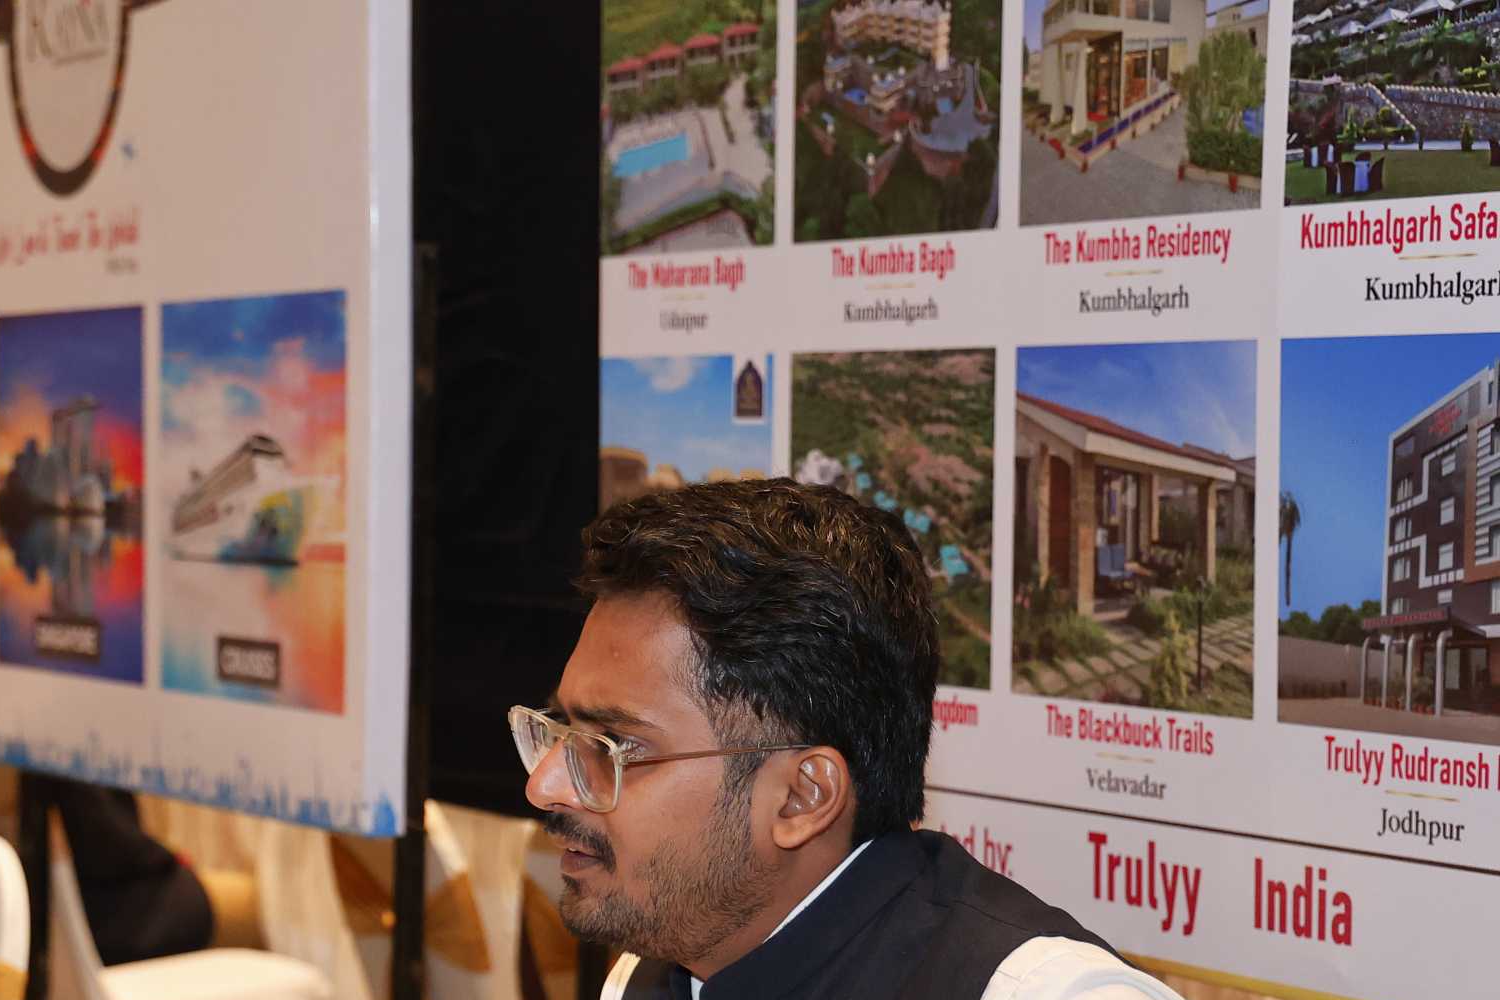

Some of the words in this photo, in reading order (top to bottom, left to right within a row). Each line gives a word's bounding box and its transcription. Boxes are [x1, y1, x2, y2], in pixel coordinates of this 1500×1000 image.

[1045, 232, 1072, 265] The
[1076, 227, 1140, 264] Kumbha
[1146, 223, 1232, 265] Residency
[1300, 204, 1442, 254] Kumbhalgarh
[628, 262, 648, 289] The
[714, 255, 746, 292] Bagh
[831, 247, 855, 277] The
[859, 244, 916, 276] Kumbha
[919, 240, 956, 280] Bagh
[843, 296, 939, 326] Kumbhalgarh
[1079, 284, 1190, 317] Kumbhalgarh
[1045, 704, 1073, 739] The
[1078, 708, 1162, 749] Blackbuck
[1166, 717, 1214, 756] Trails
[1324, 735, 1385, 786] Trulyy
[1391, 742, 1490, 790] Rudransh
[1086, 767, 1167, 799] Velavadar
[1377, 807, 1466, 845] Jodhpur
[1088, 831, 1202, 936] Trulyy
[1254, 856, 1353, 946] India
